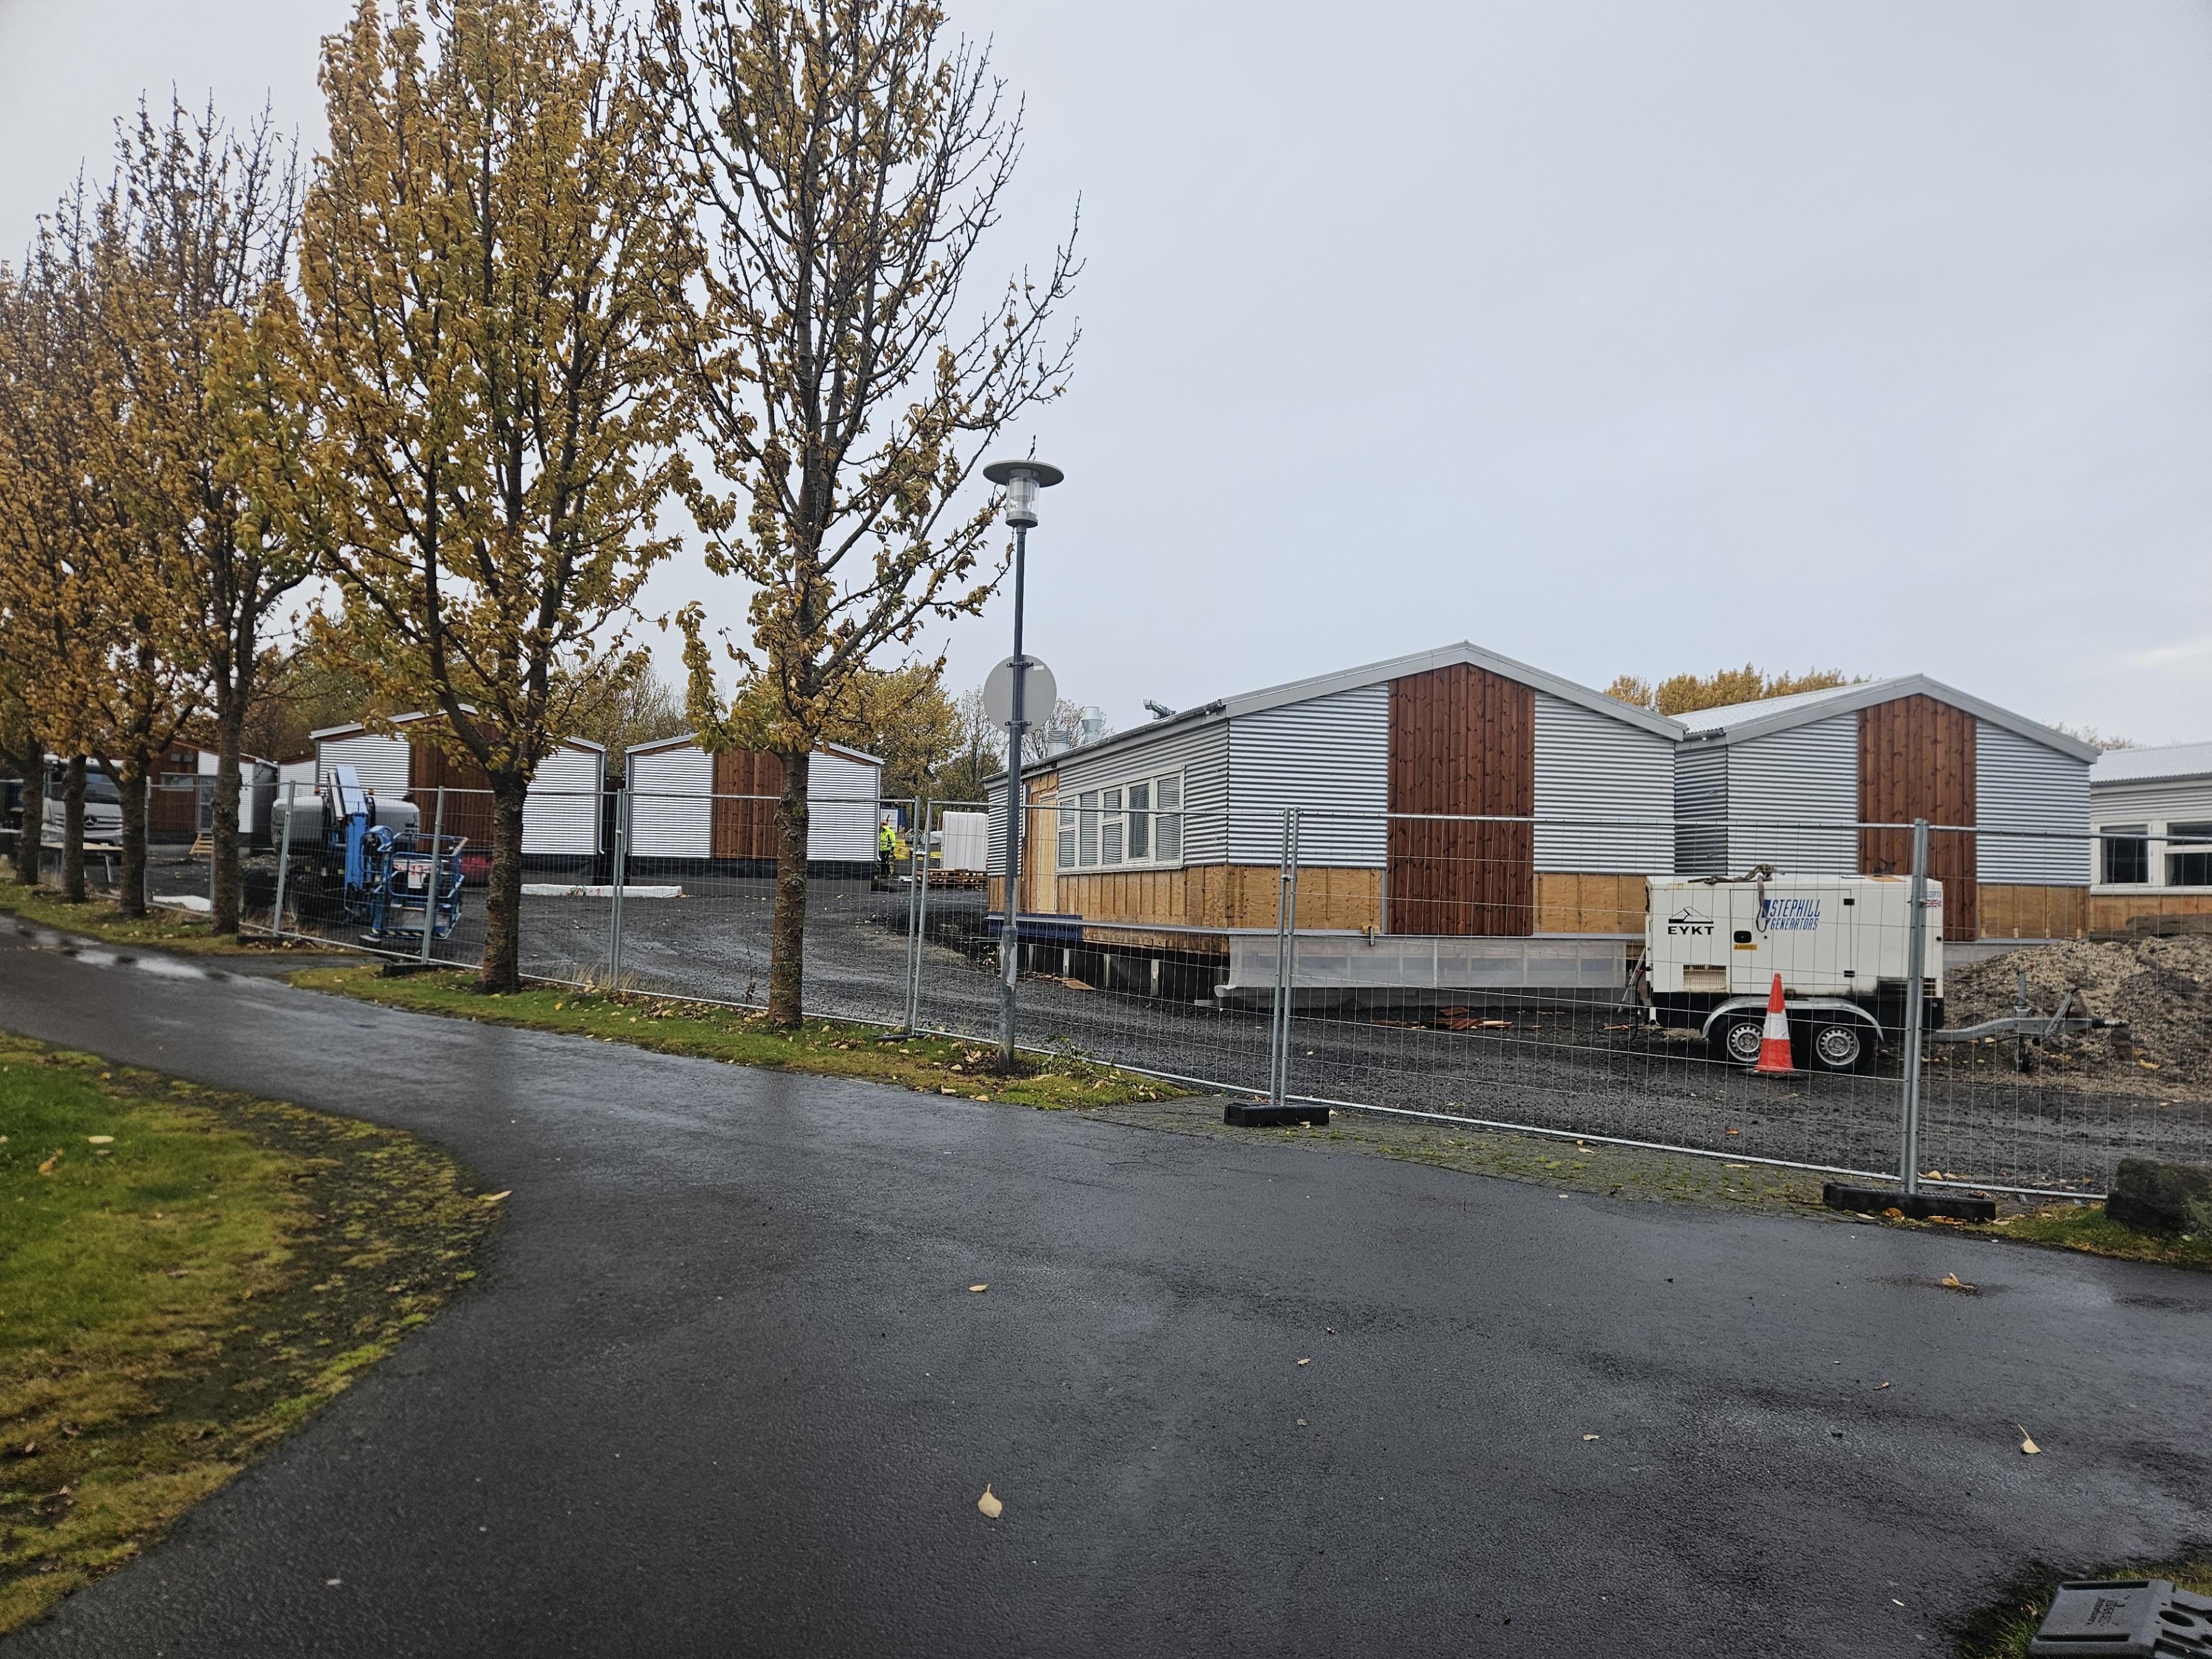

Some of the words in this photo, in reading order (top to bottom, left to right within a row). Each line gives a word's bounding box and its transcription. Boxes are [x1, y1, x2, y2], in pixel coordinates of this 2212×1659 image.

[1770, 899, 1820, 917] STEPHILL
[1770, 918, 1819, 930] GENERATORS
[1668, 926, 1714, 935] EYKT
